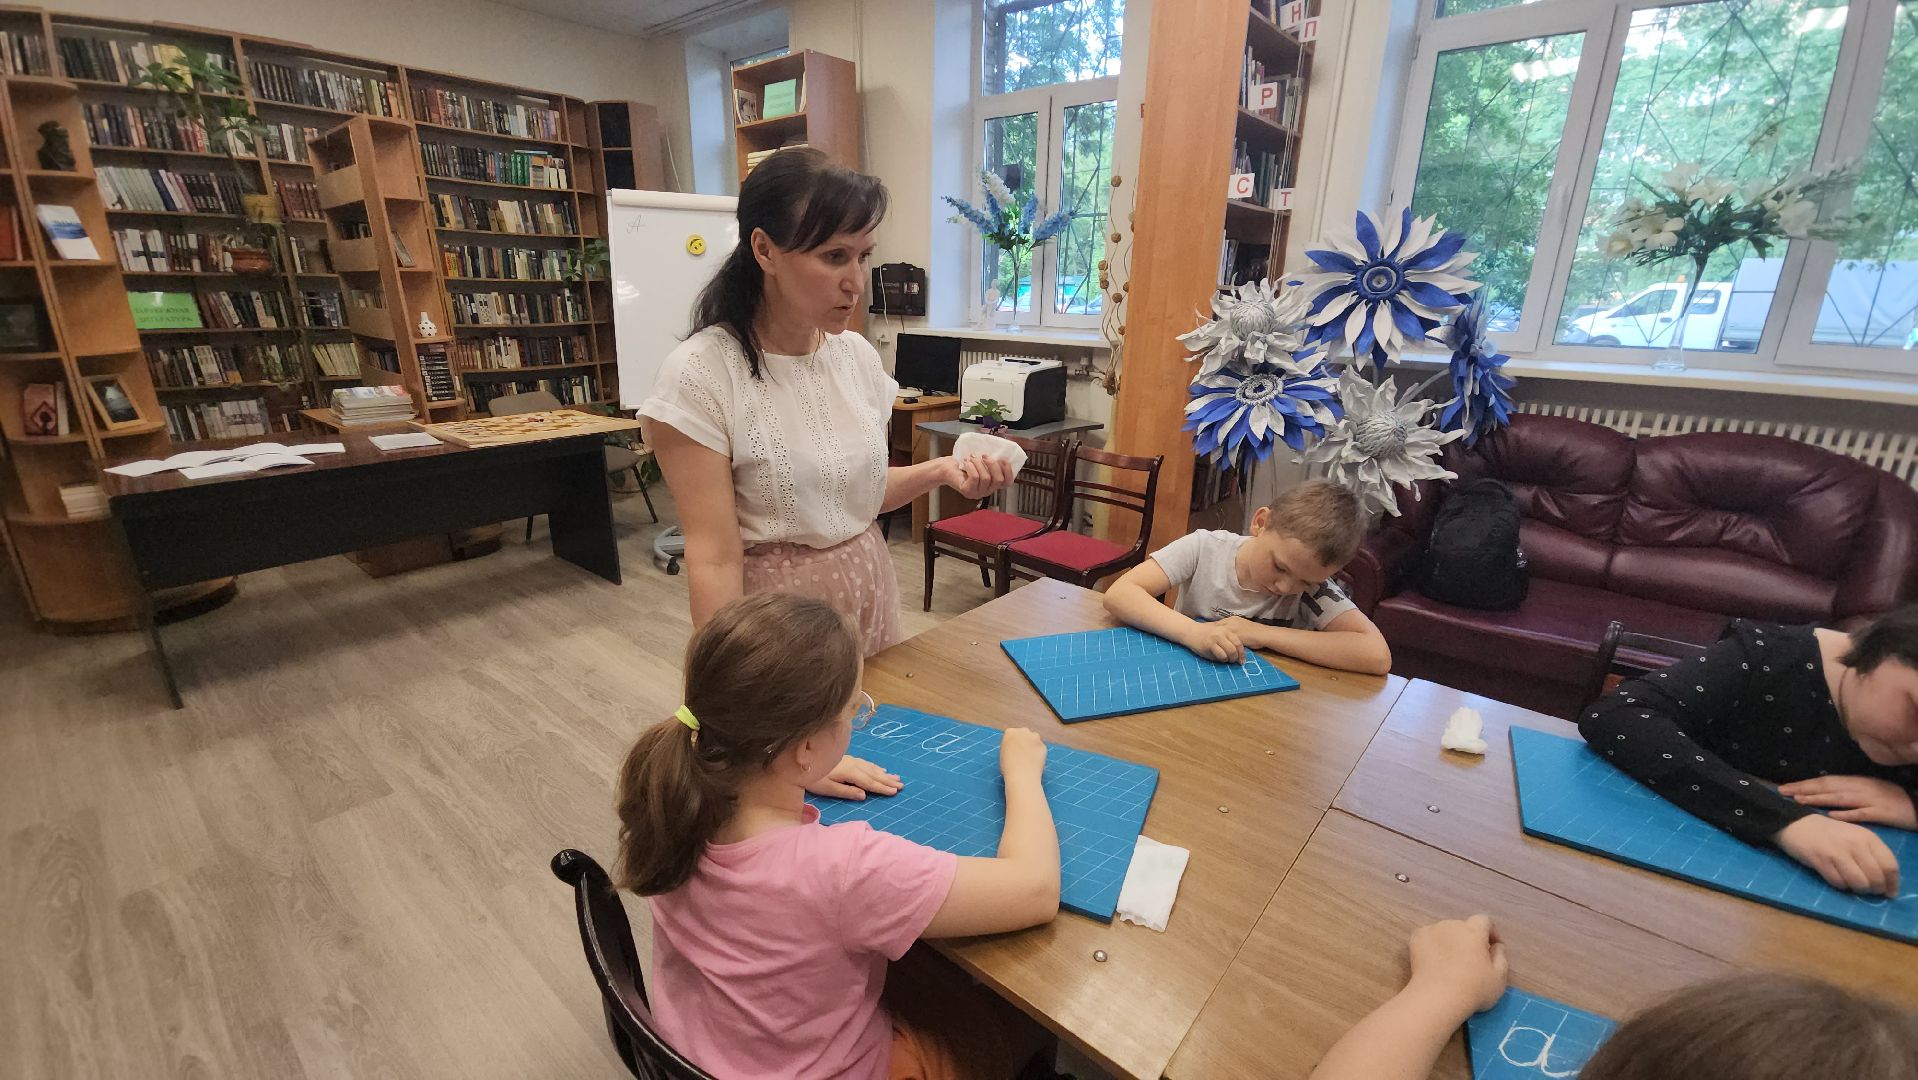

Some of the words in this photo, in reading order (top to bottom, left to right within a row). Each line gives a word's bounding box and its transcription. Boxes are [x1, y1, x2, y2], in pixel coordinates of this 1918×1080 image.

[1291, 2, 1302, 24] Н
[1303, 20, 1318, 39] П
[1261, 87, 1273, 106] Р
[1236, 176, 1249, 194] С
[1281, 191, 1292, 207] Т
